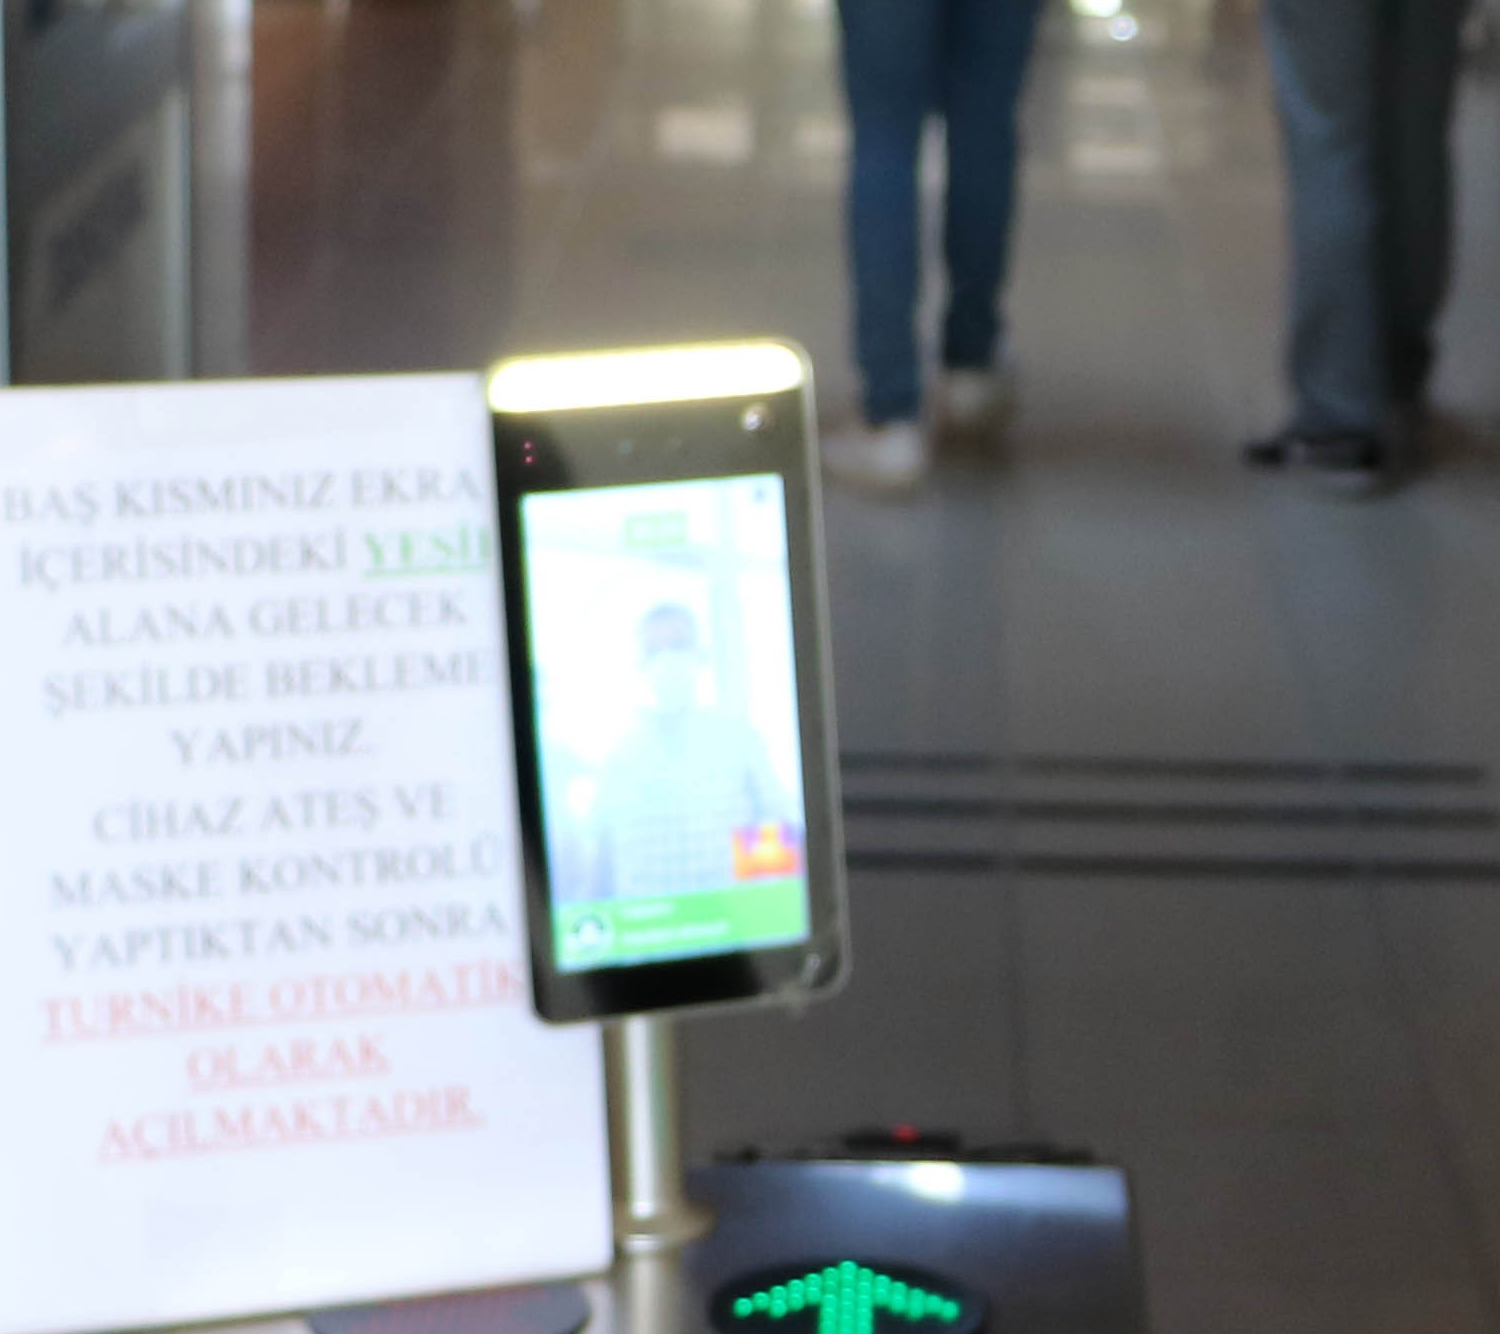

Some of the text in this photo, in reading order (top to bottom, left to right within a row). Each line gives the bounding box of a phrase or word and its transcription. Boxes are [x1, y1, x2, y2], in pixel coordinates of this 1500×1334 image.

[3, 467, 484, 528] BAŞ KISMINIZ EKRA
[62, 591, 469, 646] ALANA GELECEK
[42, 661, 251, 720] ŞEKİLDE
[92, 781, 454, 843] CİHAZ ATEŞ VE
[48, 832, 500, 909] MASKE KONTROLÜ
[48, 901, 509, 972] YAPTIKTAN SONRA
[185, 1033, 392, 1088] OLARAK
